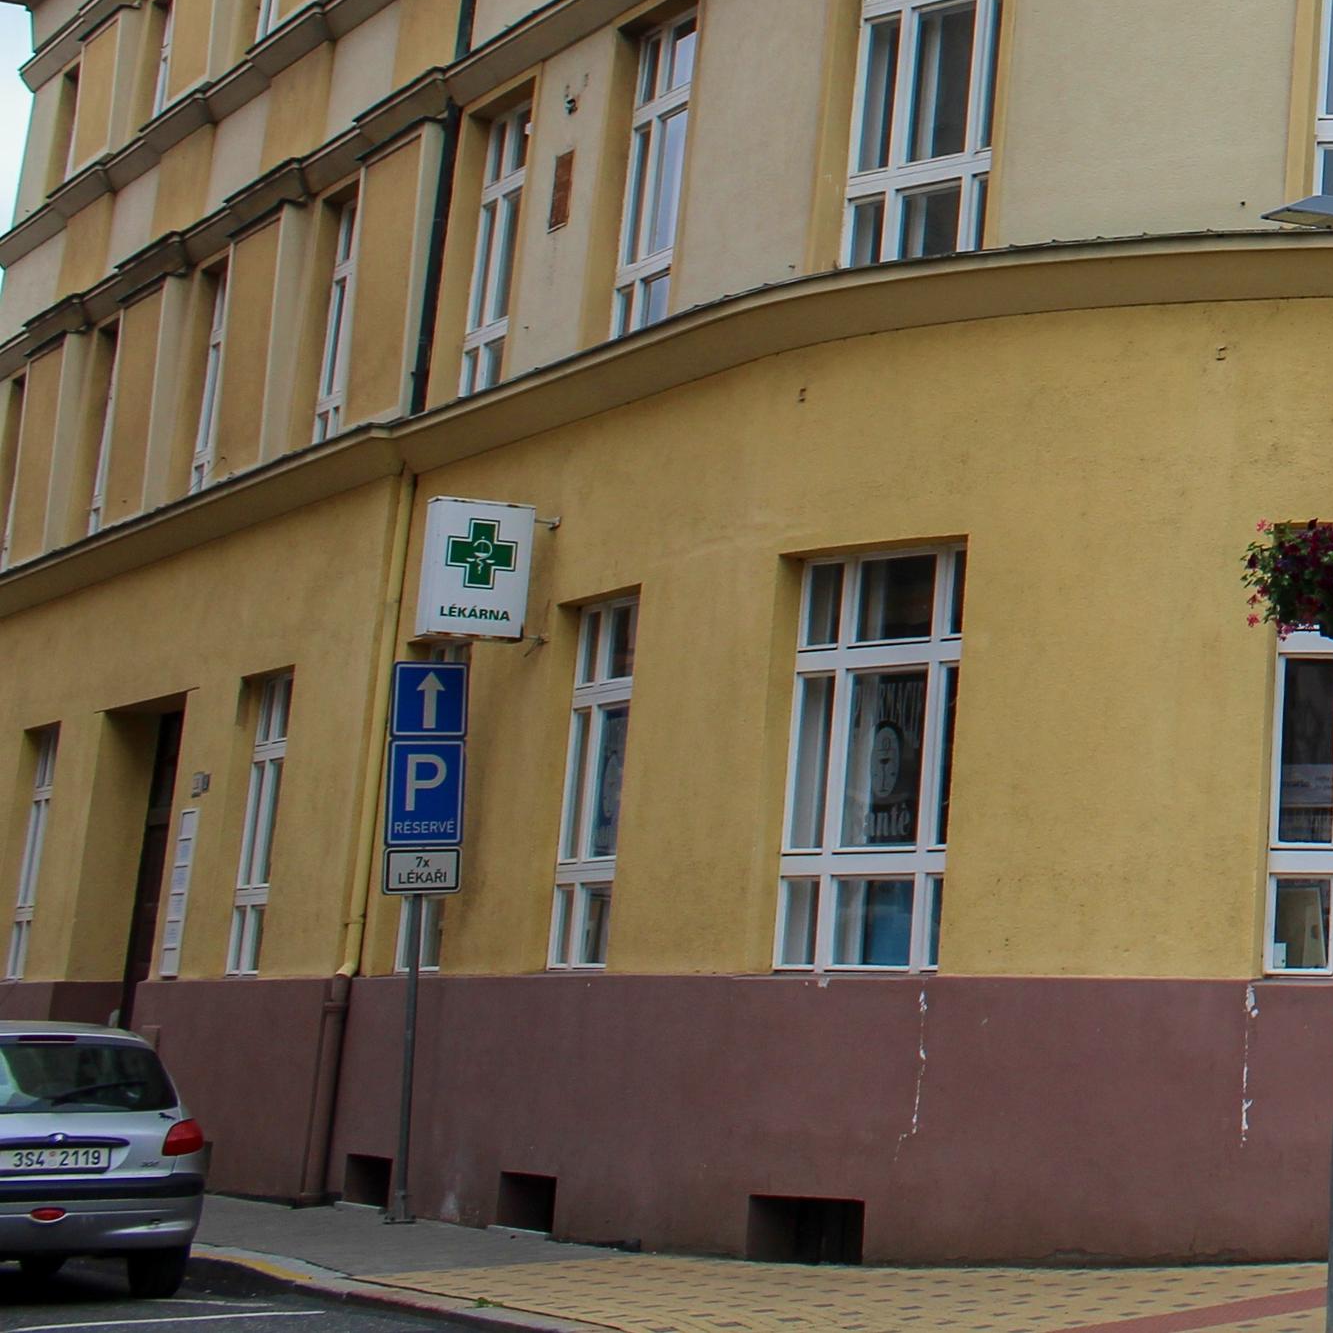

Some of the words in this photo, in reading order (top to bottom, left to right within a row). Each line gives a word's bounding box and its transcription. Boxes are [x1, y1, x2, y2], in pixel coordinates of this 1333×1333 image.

[440, 603, 510, 622] LÉKÁRNA
[405, 753, 447, 811] P
[394, 819, 455, 834] RÉSERVÉ
[415, 856, 430, 868] 7x
[398, 869, 447, 884] LÉKAŘI
[13, 1151, 45, 1167] 3S4
[60, 1150, 101, 1167] 2119
